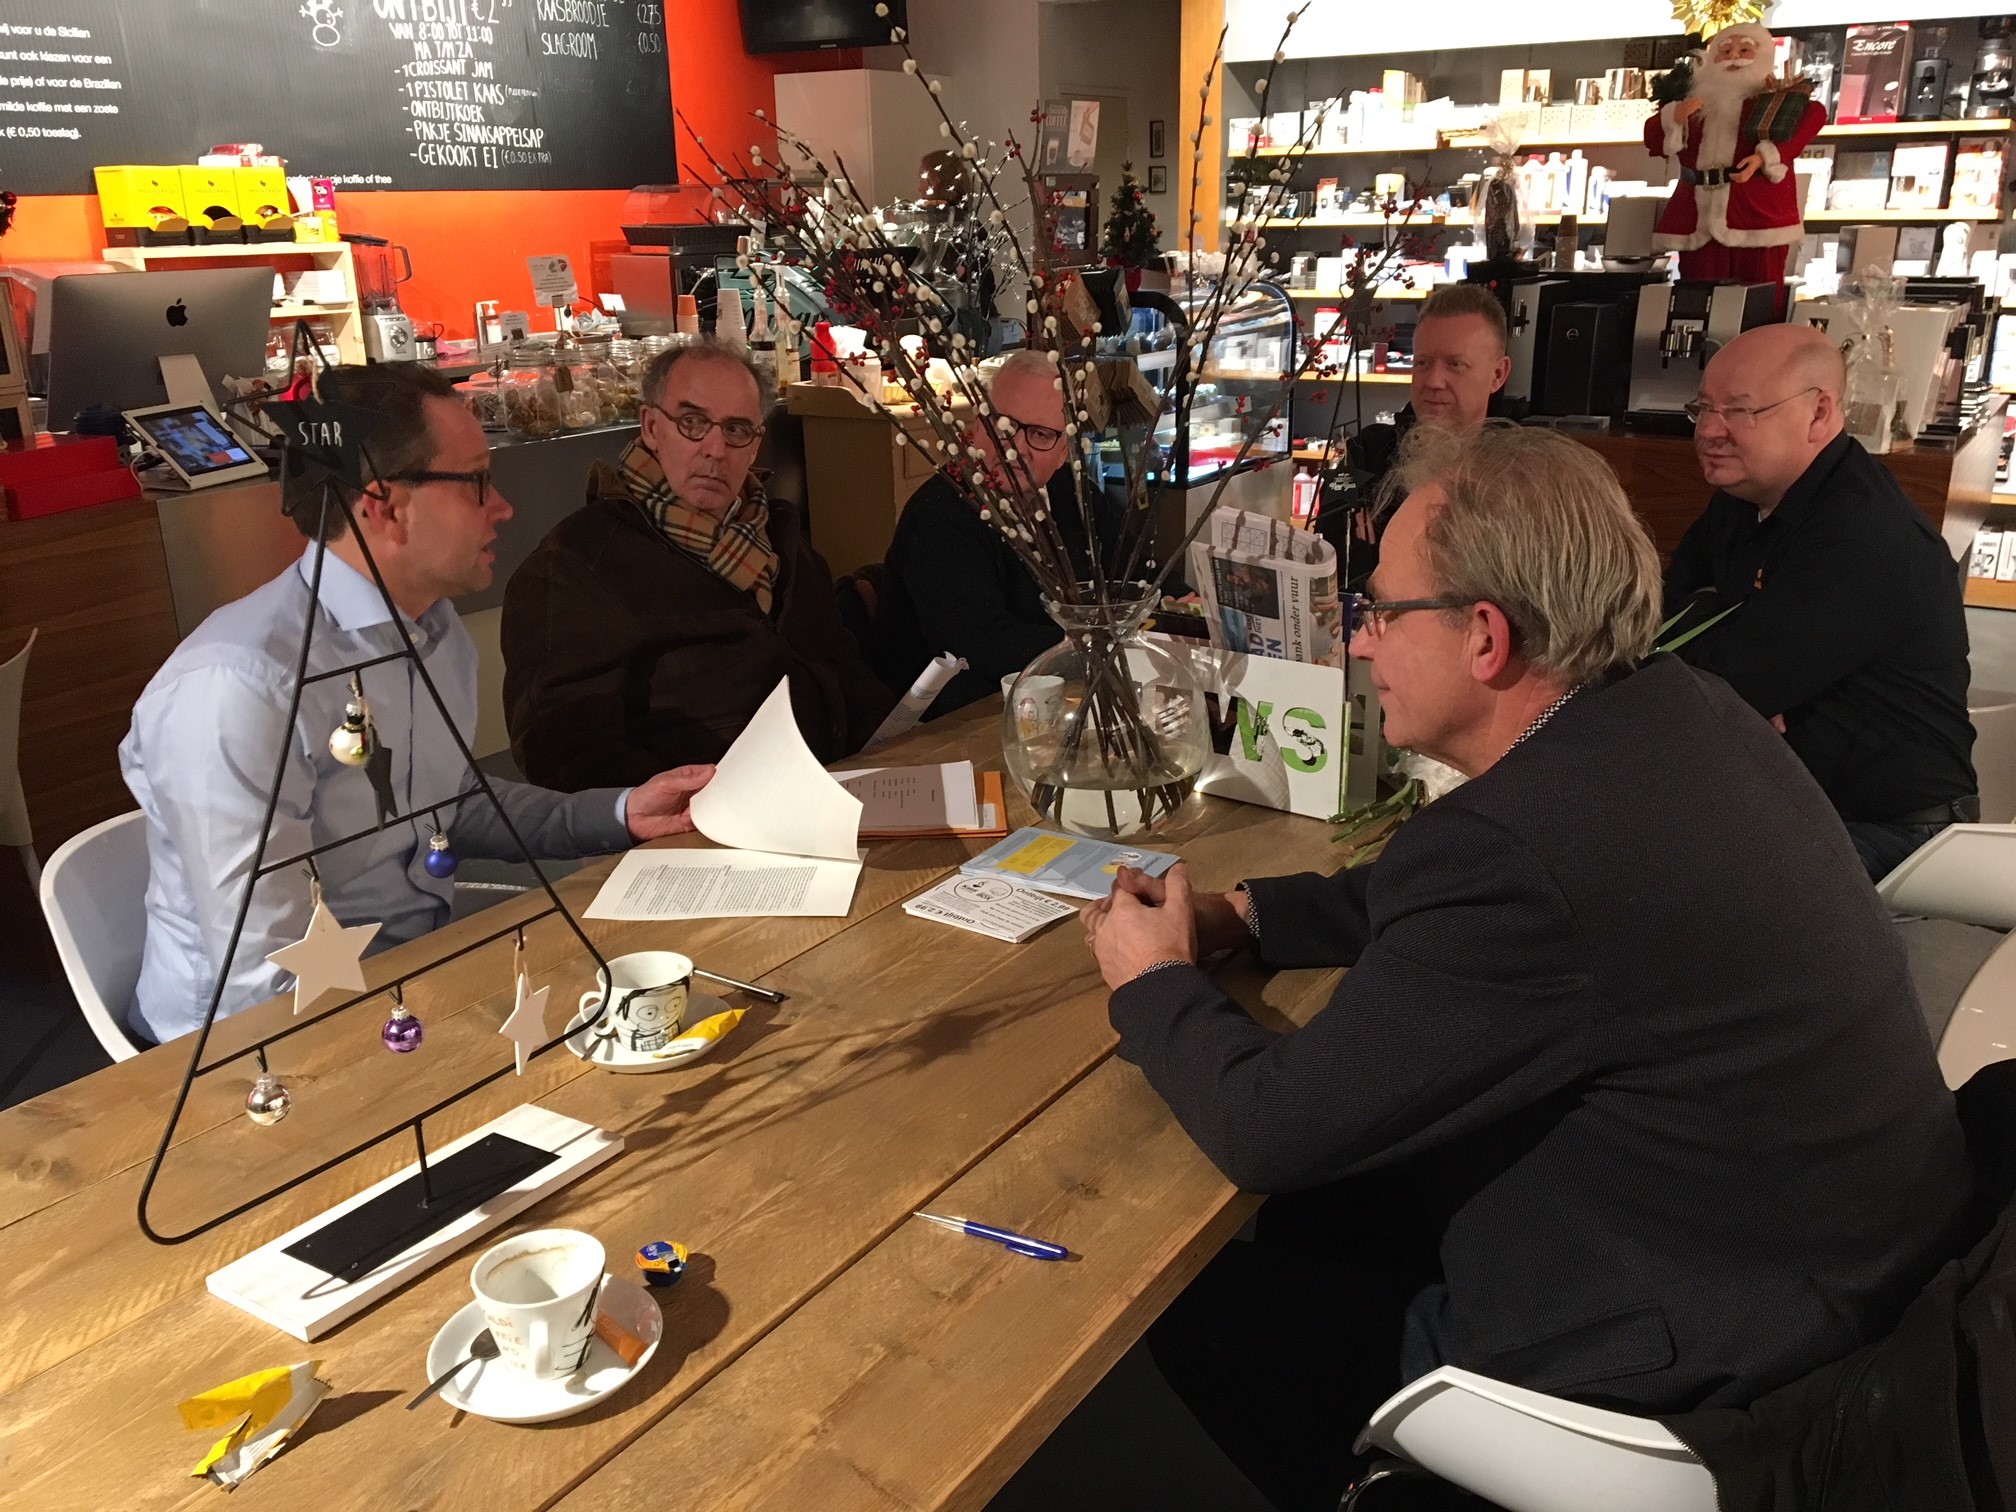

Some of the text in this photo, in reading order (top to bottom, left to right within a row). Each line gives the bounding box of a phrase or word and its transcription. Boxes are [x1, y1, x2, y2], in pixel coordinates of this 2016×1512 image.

[10, 26, 33, 35] voor
[34, 27, 42, 36] u
[43, 26, 57, 37] de
[58, 26, 91, 38] Sicilian
[388, 22, 414, 40] VAN
[418, 21, 445, 40] 8:00
[465, 25, 493, 45] 11:00
[413, 41, 432, 60] MA
[455, 41, 473, 58] ZA
[541, 32, 598, 60] SLAGROOM
[1852, 39, 1897, 51] Encore
[19, 51, 39, 61] ook
[40, 51, 71, 62] kiezen
[71, 54, 93, 63] voor
[94, 55, 113, 64] een
[471, 57, 493, 80] JAM
[35, 76, 45, 87] of
[46, 79, 68, 88] voor
[69, 78, 83, 88] de
[83, 78, 122, 89] Brazilian
[414, 81, 468, 101] PISTOLET
[473, 82, 505, 106] KAAS
[26, 101, 53, 113] koffie
[54, 103, 73, 113] met
[74, 104, 92, 113] een
[93, 104, 119, 114] zoete
[411, 100, 485, 123] ONTBIJTKOEK
[18, 126, 41, 138] 0,50
[413, 120, 452, 143] PAKJE
[453, 122, 544, 149] SINAASAPPELSAP
[418, 142, 478, 168] GEKOOKT
[483, 146, 499, 169] EI
[343, 174, 364, 184] koffie
[365, 174, 374, 184] of
[375, 175, 392, 184] thee
[298, 421, 342, 447] STAR
[1290, 575, 1299, 603] vuur
[1290, 606, 1302, 637] onder
[1016, 888, 1045, 901] Ontbijt
[915, 904, 936, 912] 2.99
[943, 912, 976, 924] Ontbijt
